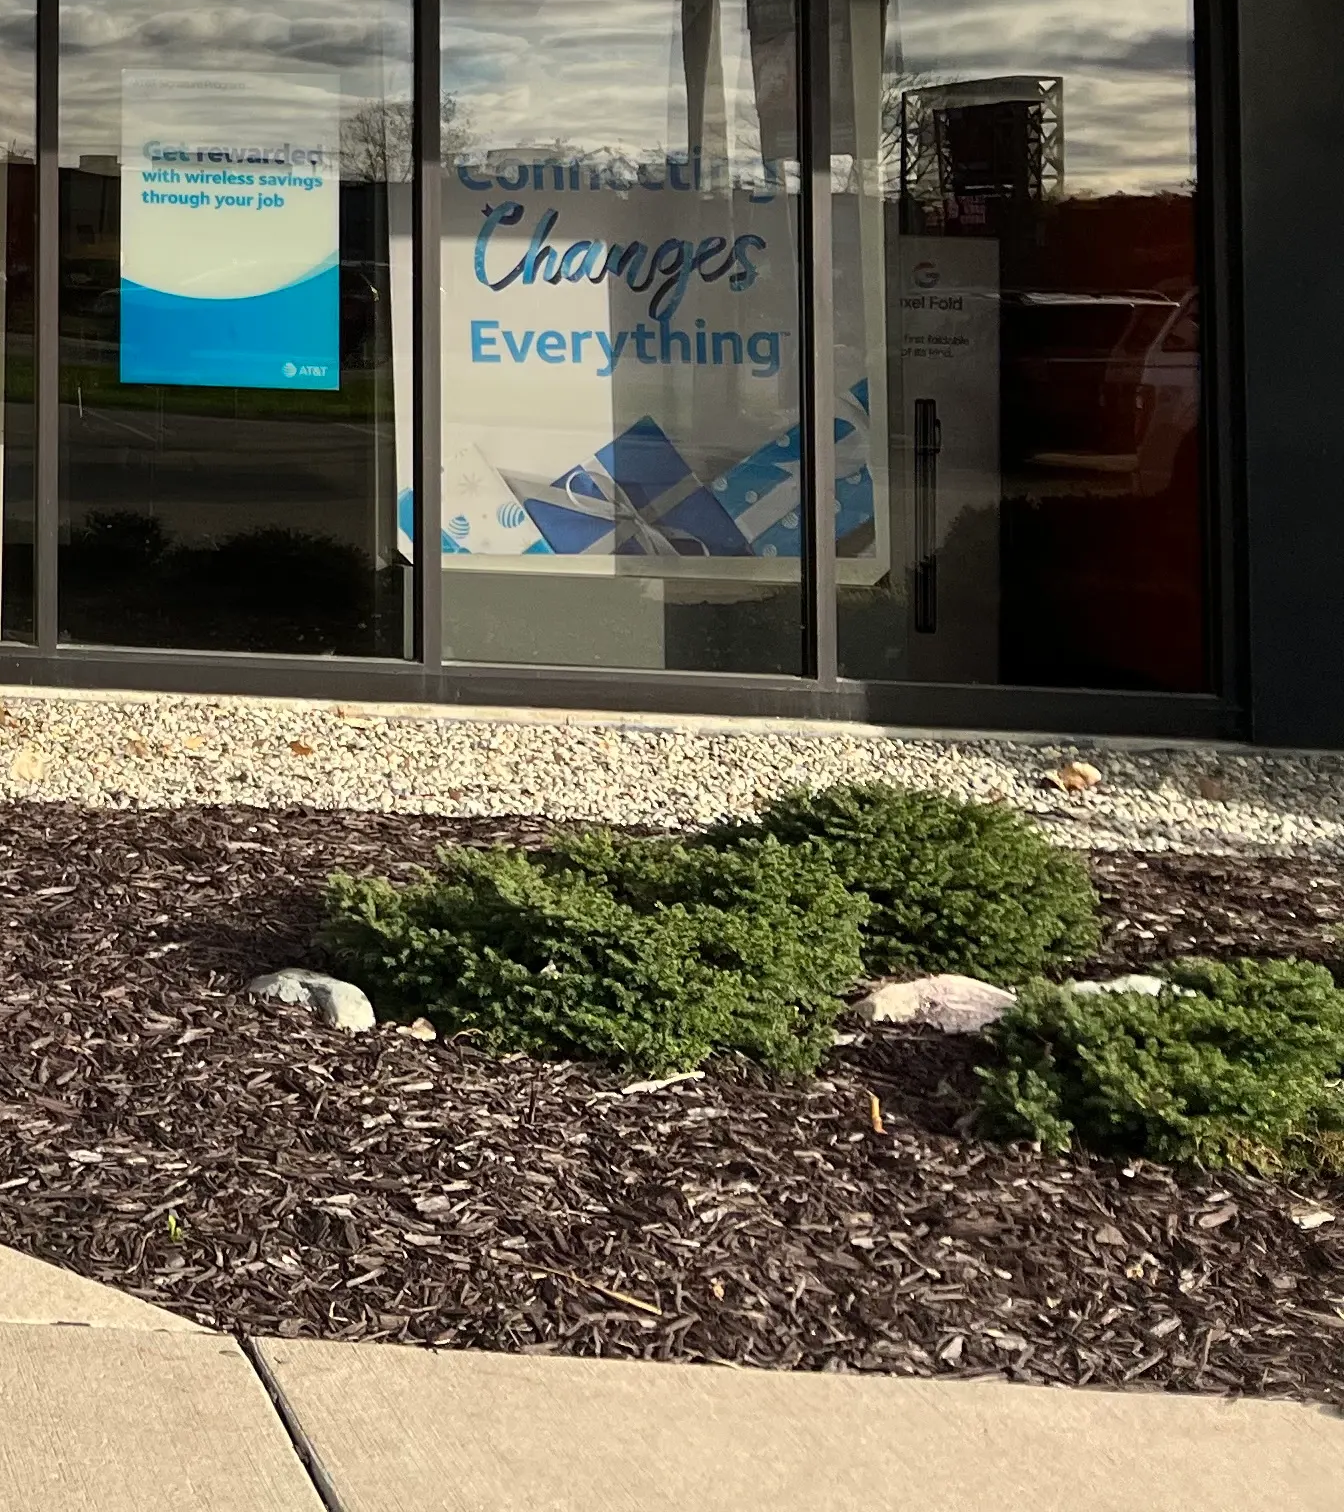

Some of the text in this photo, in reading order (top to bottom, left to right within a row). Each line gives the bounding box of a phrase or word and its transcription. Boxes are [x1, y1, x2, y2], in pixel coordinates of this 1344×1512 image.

[143, 140, 323, 165] Get rewarded
[142, 168, 323, 190] with wireless savings
[142, 190, 285, 210] through your job
[473, 201, 767, 322] Changes
[930, 296, 963, 311] Fold
[299, 365, 328, 377] AT&T
